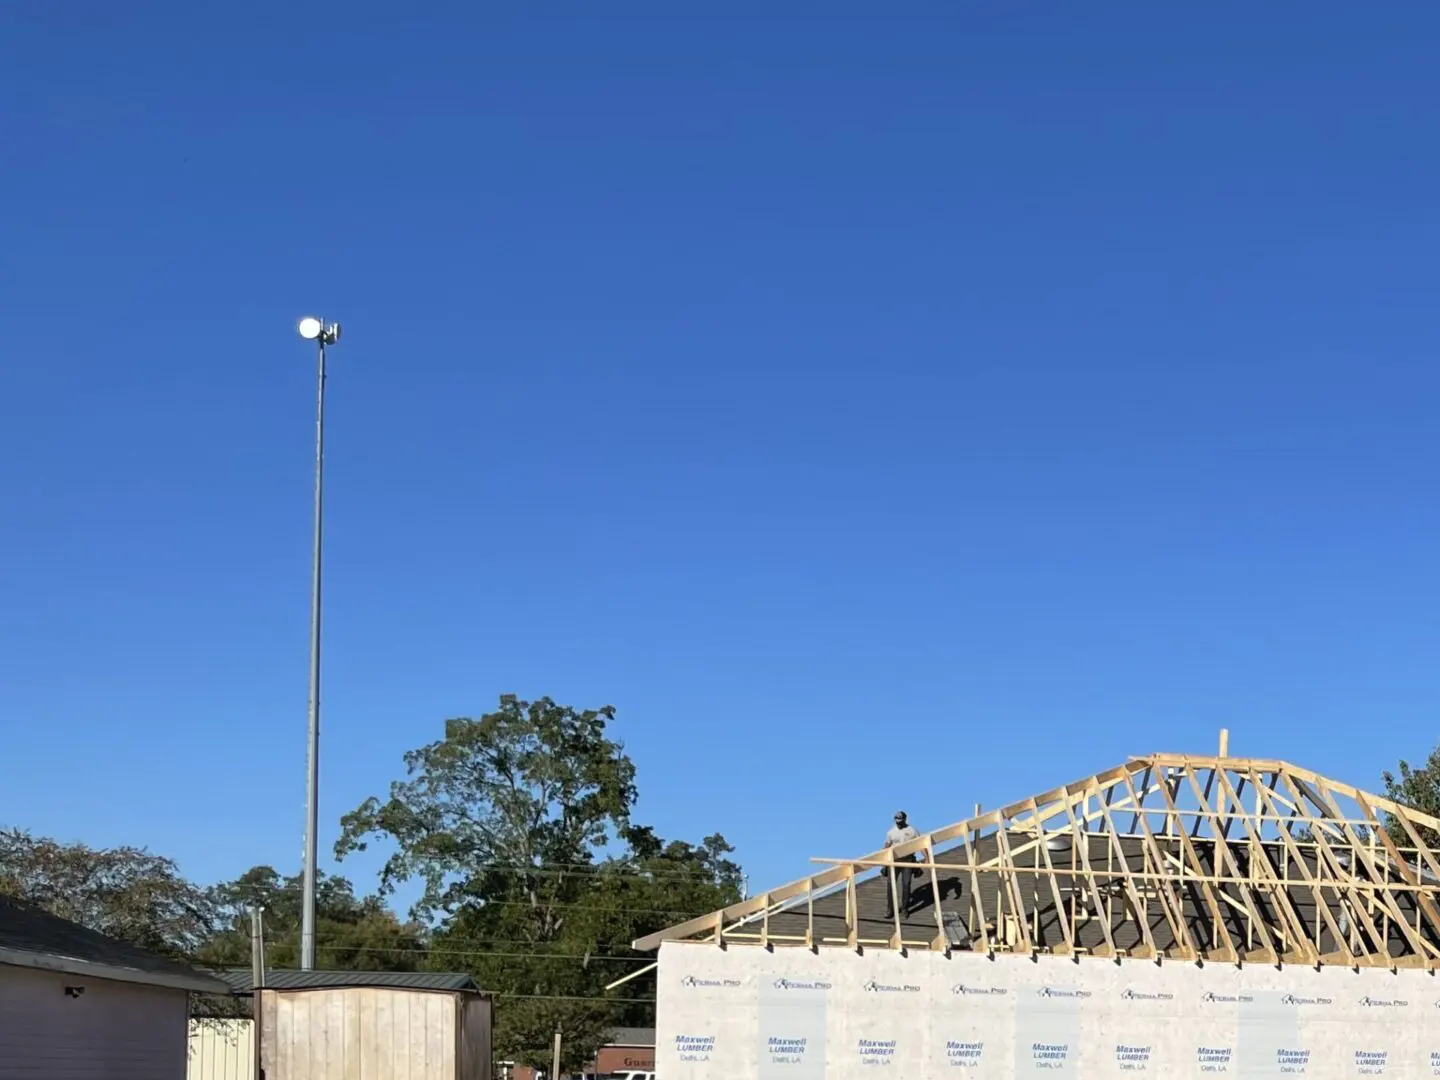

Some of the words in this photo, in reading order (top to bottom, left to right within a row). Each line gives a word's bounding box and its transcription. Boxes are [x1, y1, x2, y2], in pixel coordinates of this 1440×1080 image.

[675, 1035, 715, 1044] Maxwell
[768, 1037, 806, 1046] Maxwell
[858, 1039, 896, 1048] Maxwell
[677, 1044, 714, 1053] LUMBER
[769, 1046, 805, 1054] LUMBER
[946, 1041, 984, 1050] Maxwell
[1032, 1043, 1068, 1052] Maxwell
[1116, 1045, 1151, 1054] Maxwell
[859, 1047, 894, 1056] LUMBER
[947, 1050, 982, 1058] LUMBER
[1034, 1052, 1066, 1060] LUMBER
[1197, 1047, 1232, 1056] Maxwell
[1276, 1048, 1310, 1057] Maxwell
[1355, 1050, 1388, 1059] Maxwell
[1117, 1054, 1149, 1062] LUMBER
[1198, 1055, 1230, 1064] LUMBER
[1278, 1056, 1308, 1065] LUMBER
[1356, 1058, 1386, 1066] LUMBER
